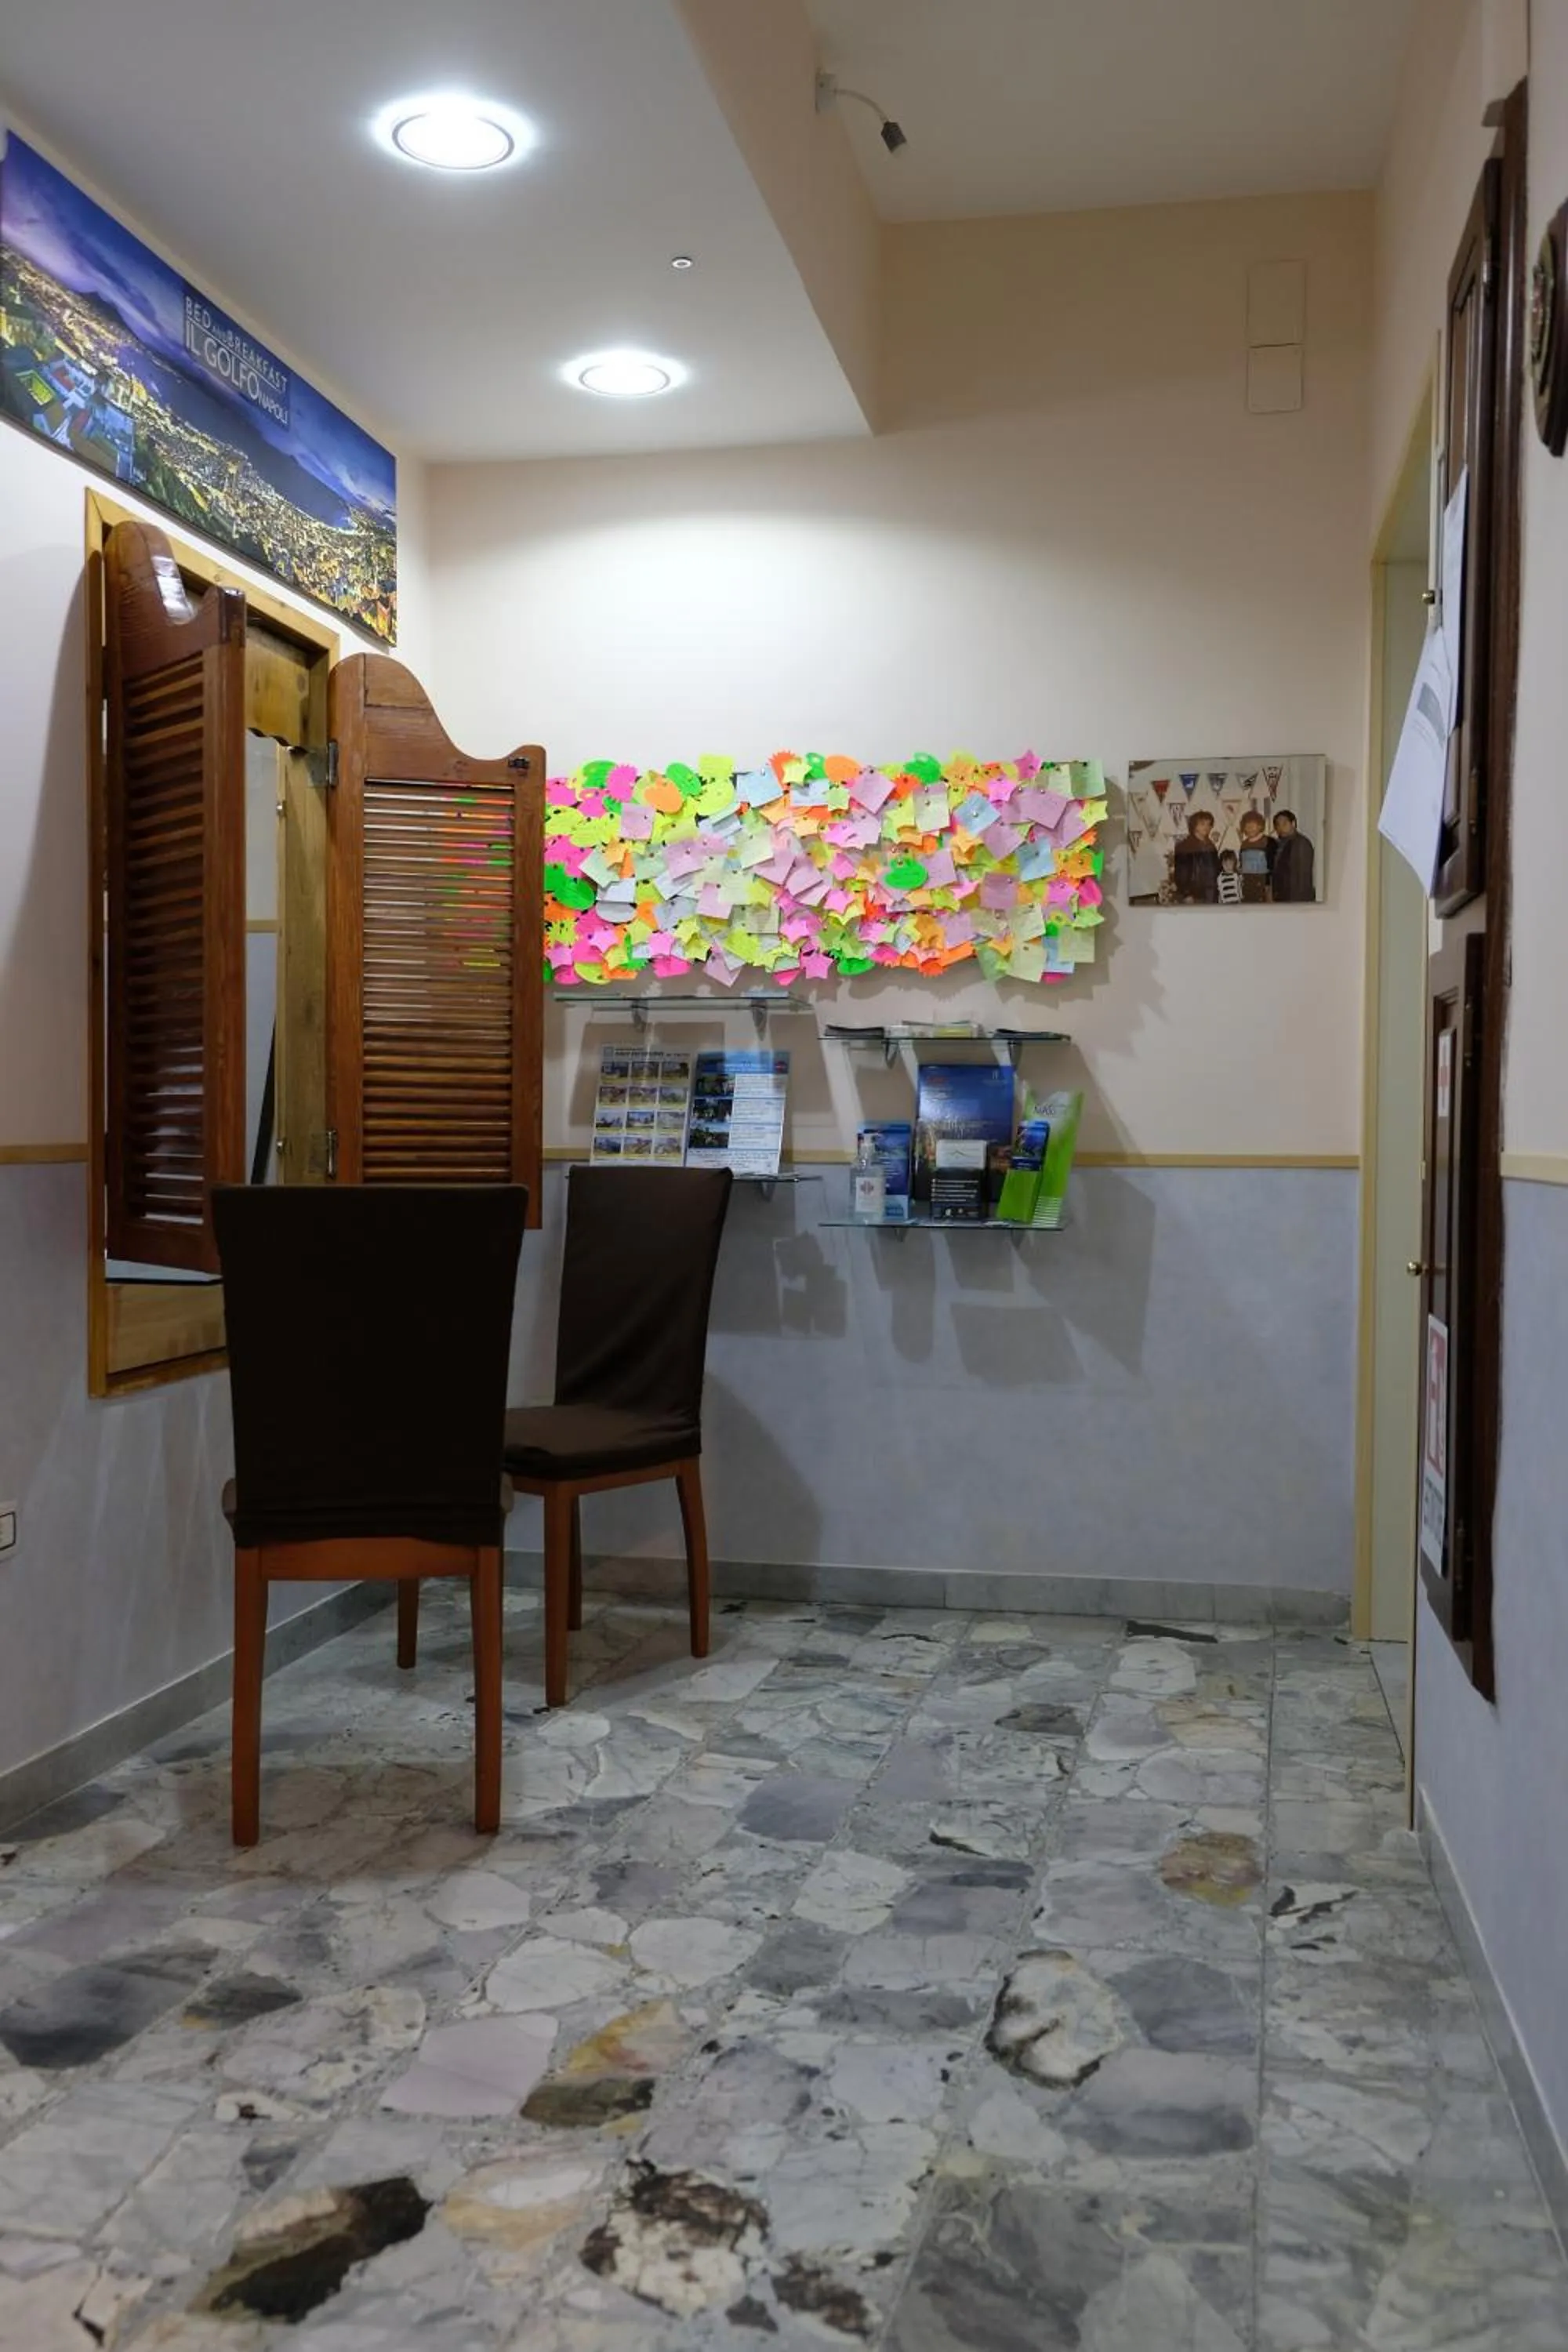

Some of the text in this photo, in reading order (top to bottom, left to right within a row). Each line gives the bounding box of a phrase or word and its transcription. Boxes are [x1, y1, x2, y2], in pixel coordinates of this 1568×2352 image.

[185, 296, 212, 329] BED
[227, 330, 288, 393] BREAKFAST
[185, 320, 289, 425] IL GOLFO NAPOLI
